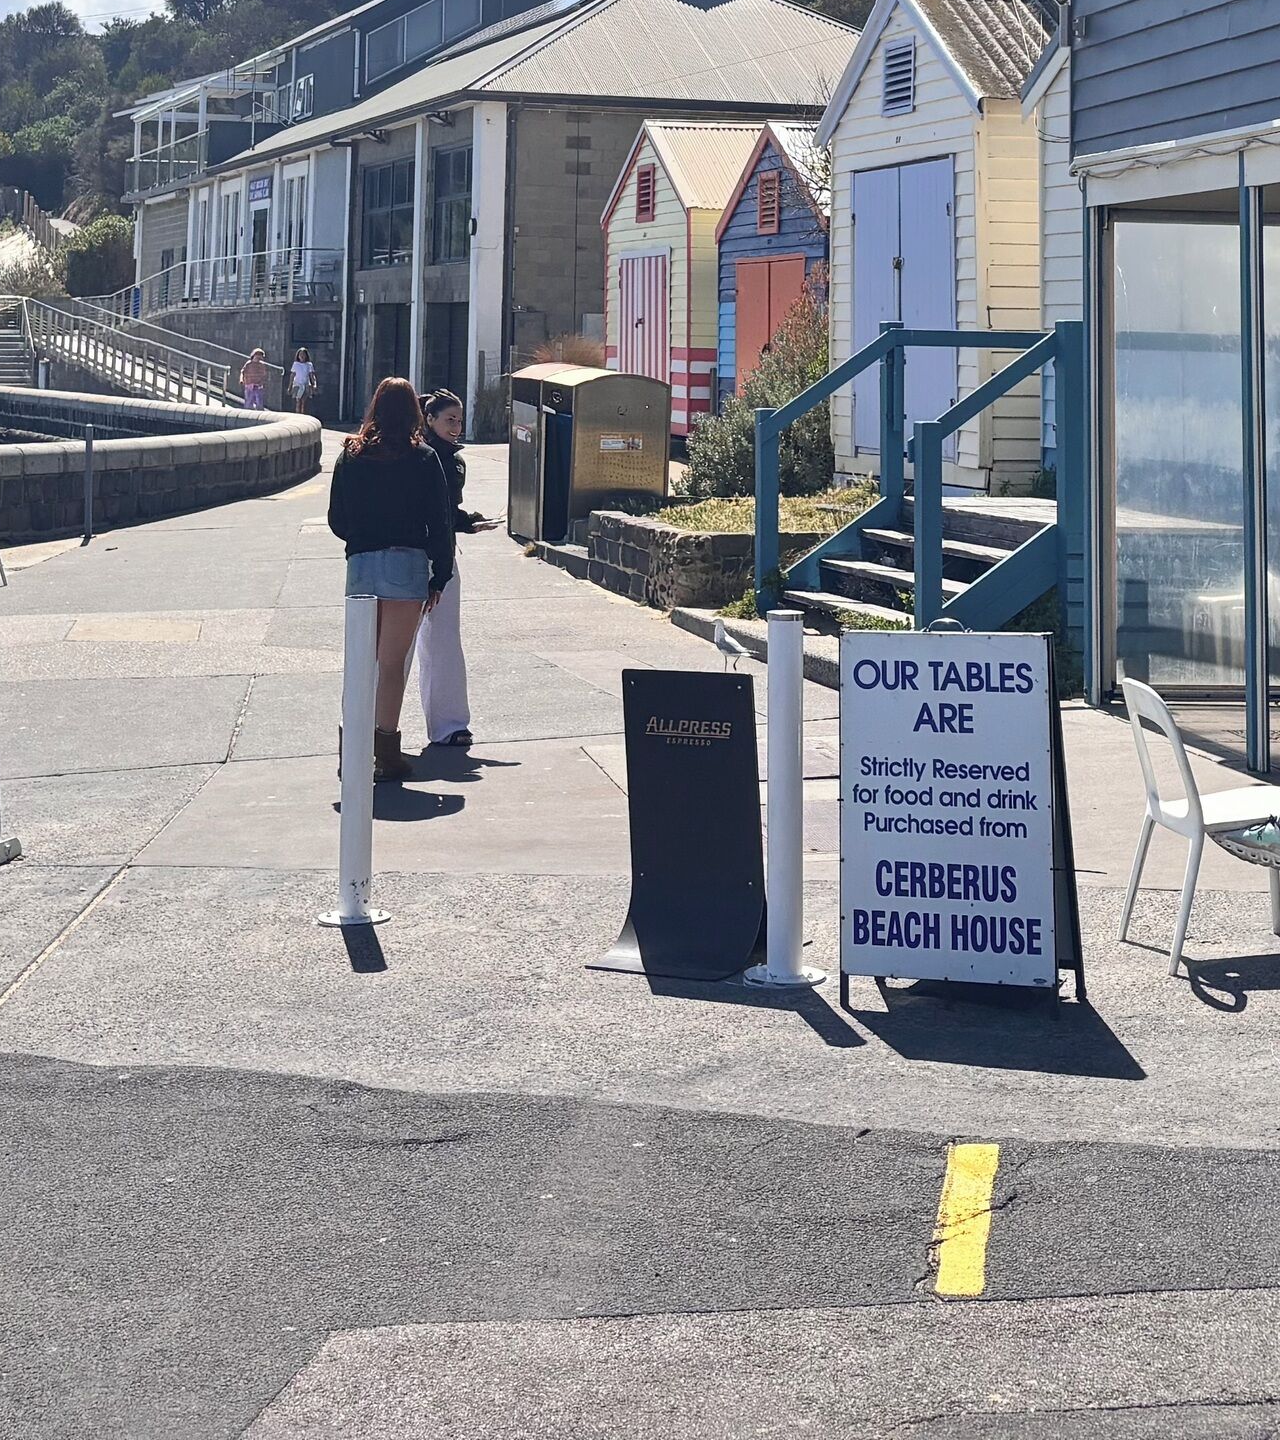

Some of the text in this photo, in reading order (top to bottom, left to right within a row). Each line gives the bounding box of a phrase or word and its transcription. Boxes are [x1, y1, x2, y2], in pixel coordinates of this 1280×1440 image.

[853, 659, 1034, 694] OUR TABLES
[646, 716, 732, 737] ALLPRESS
[912, 702, 974, 734] ARE
[666, 737, 712, 746] ESPRESSO
[860, 756, 1030, 782] Strictly Reserved
[852, 783, 1038, 810] for food and drink
[864, 812, 1028, 839] Purchased from
[875, 859, 1018, 903] CERBERUS
[853, 909, 1042, 956] BEACH HOUSE
